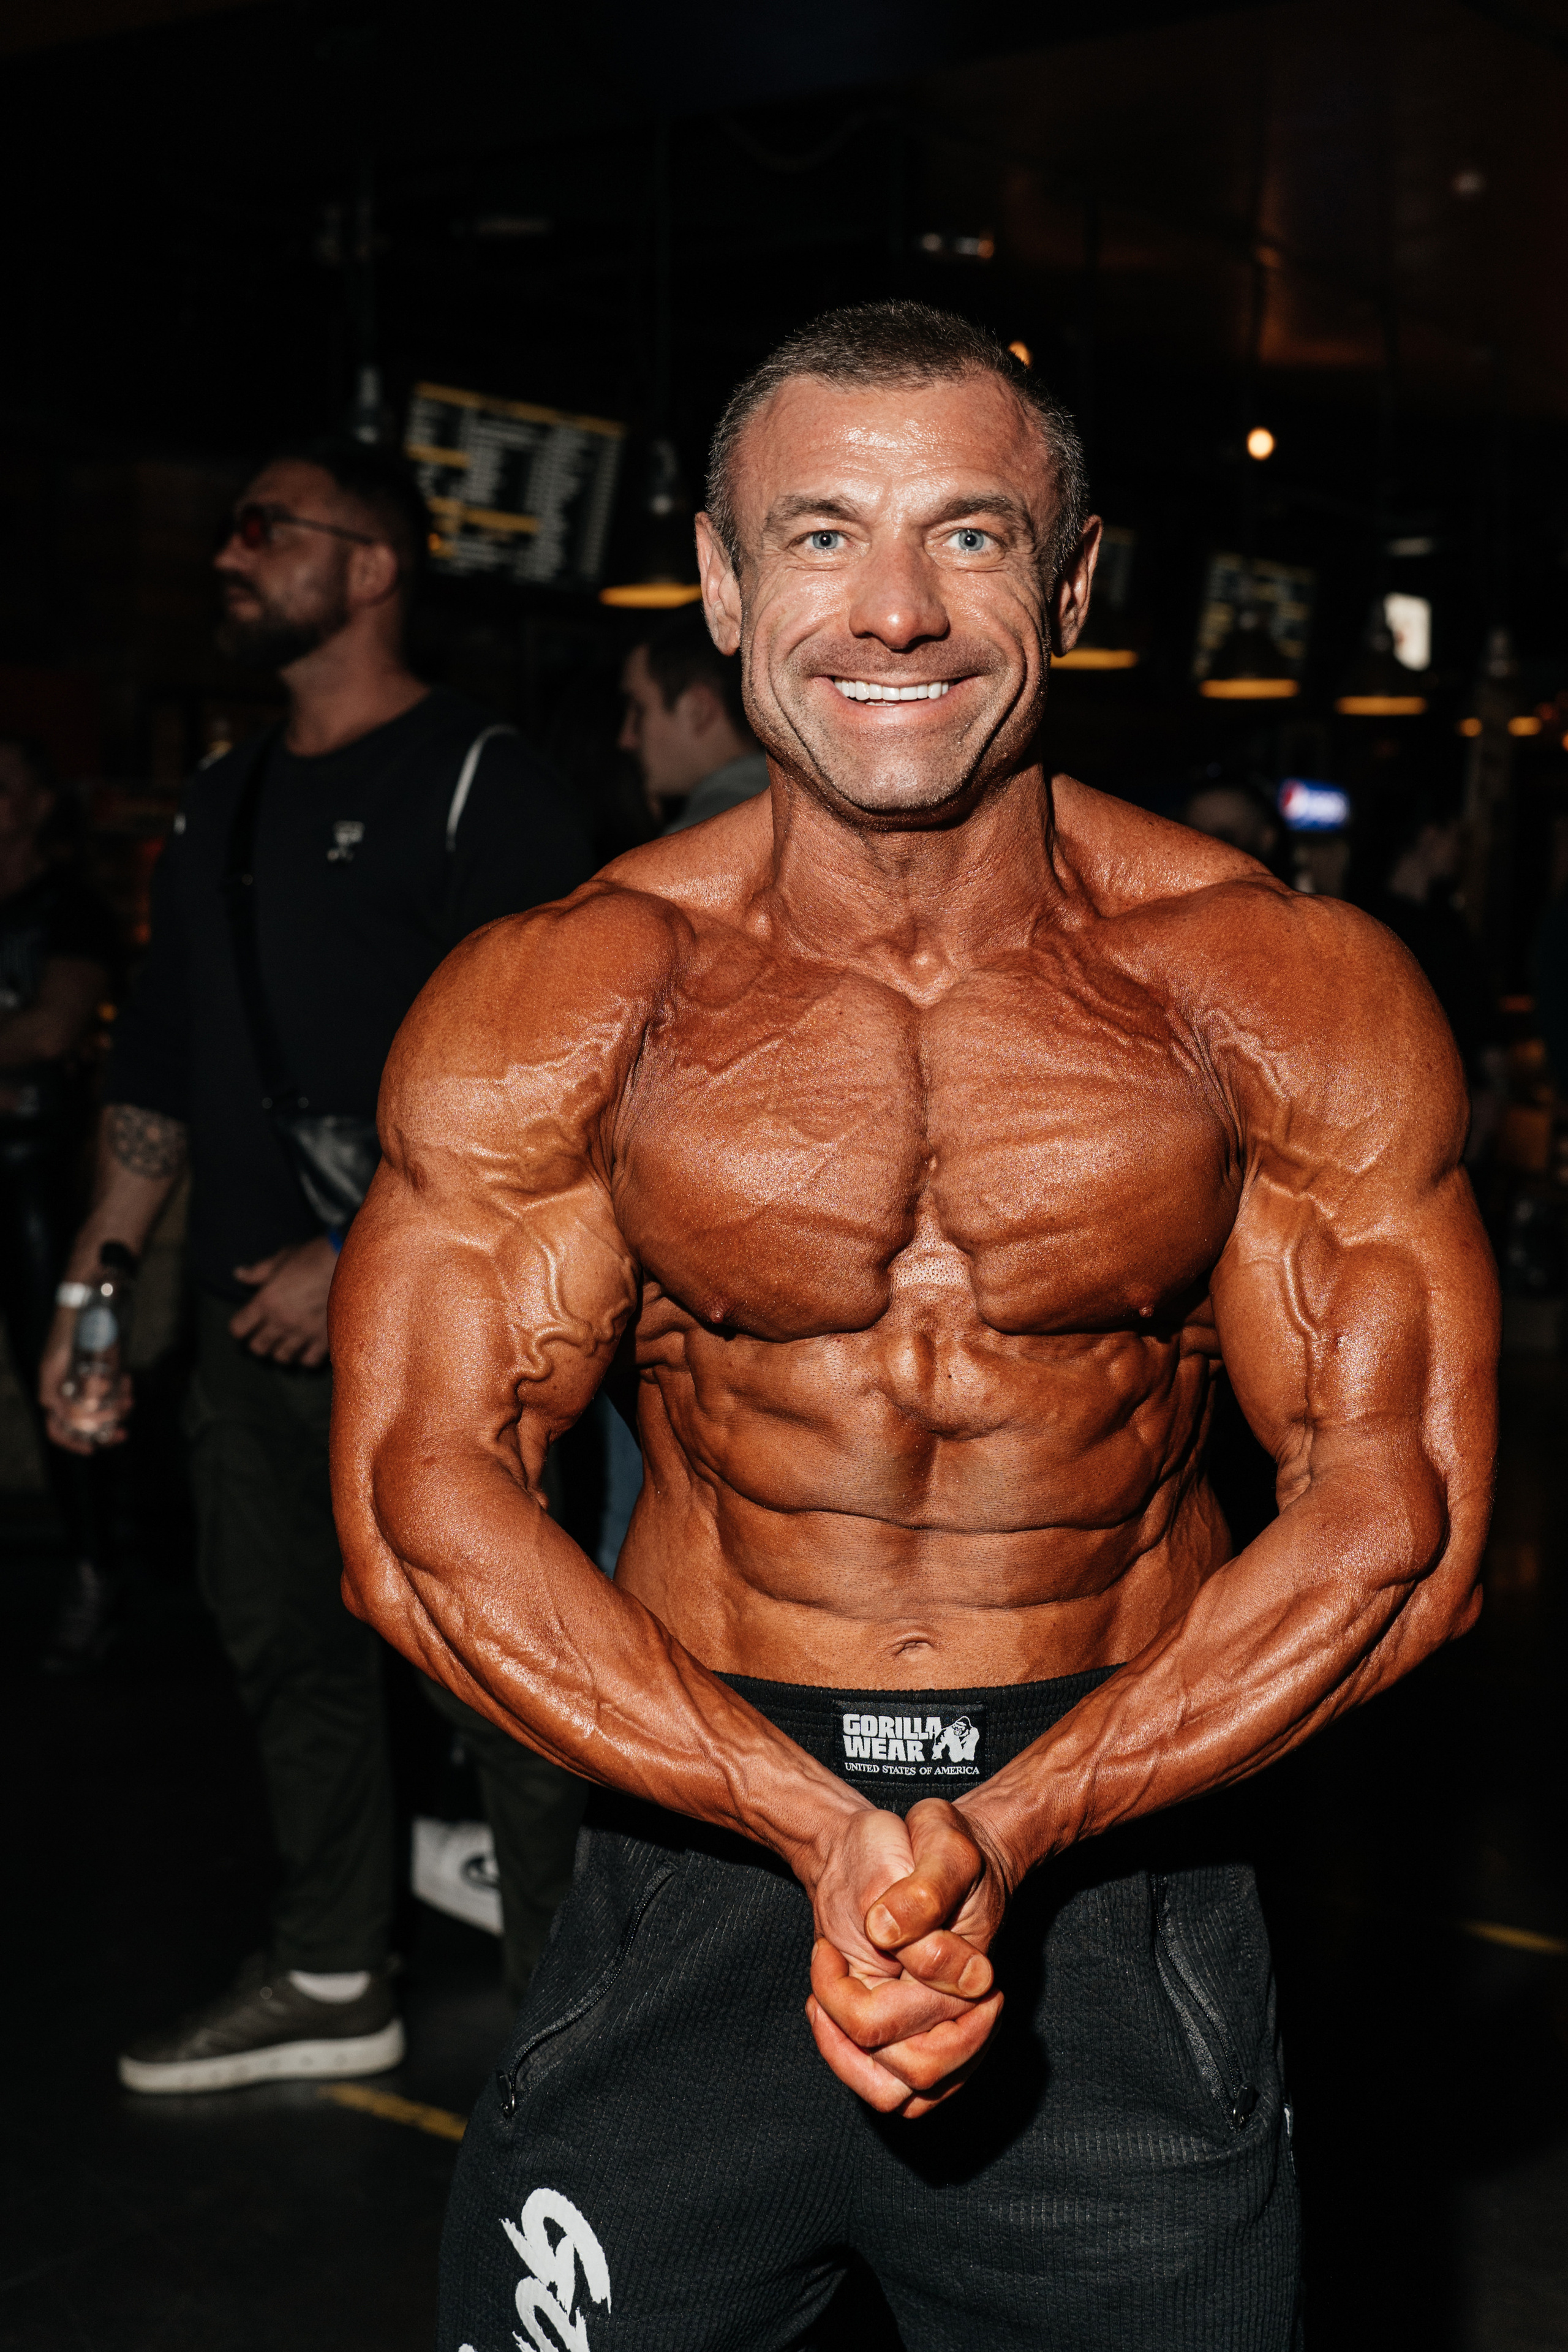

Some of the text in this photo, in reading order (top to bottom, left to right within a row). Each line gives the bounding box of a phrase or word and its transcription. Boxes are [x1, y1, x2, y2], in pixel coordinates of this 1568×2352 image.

[843, 1714, 942, 1740] GORILLA
[842, 1735, 925, 1762] WEAR
[844, 1762, 979, 1776] UNITED STATES OF AMERICA
